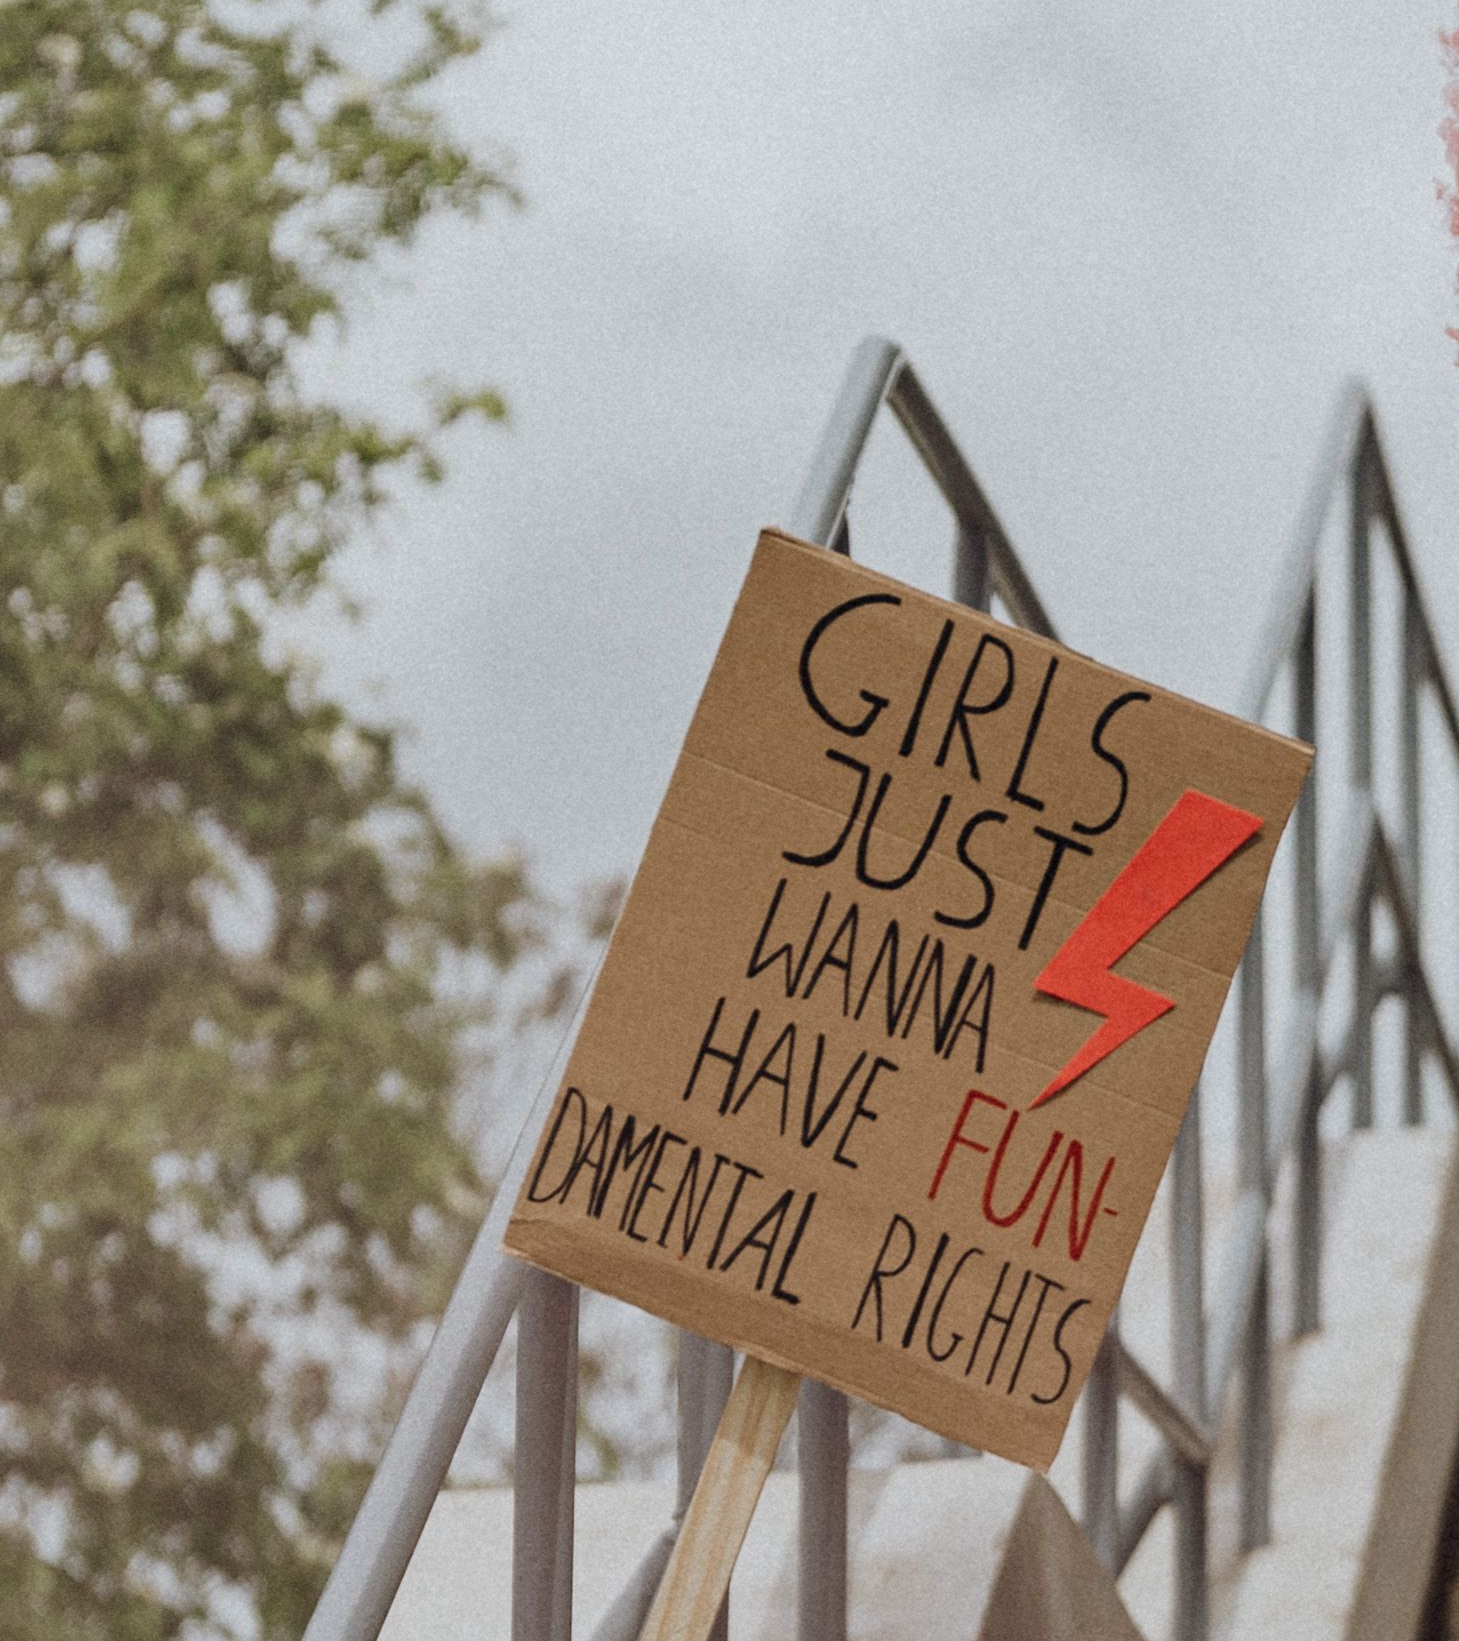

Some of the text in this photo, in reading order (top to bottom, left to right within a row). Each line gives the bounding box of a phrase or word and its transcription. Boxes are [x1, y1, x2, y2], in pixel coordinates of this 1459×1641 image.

[798, 592, 1152, 837] GIRLS
[781, 748, 1094, 950] JUST
[746, 877, 996, 1074] WANNA
[682, 997, 899, 1170] HAVE
[526, 1086, 1092, 1405] DAMENTAL RIGHTS
